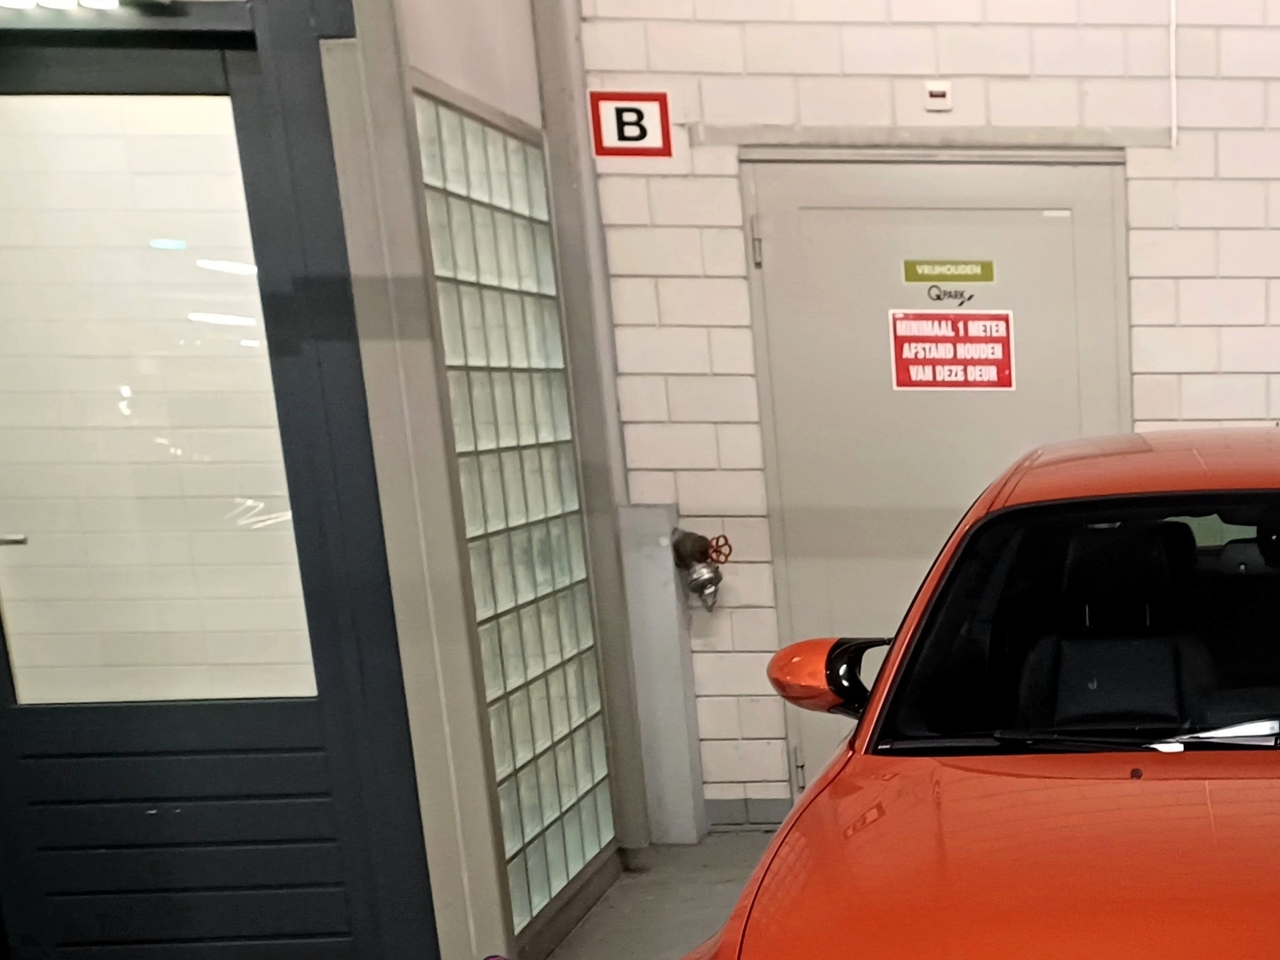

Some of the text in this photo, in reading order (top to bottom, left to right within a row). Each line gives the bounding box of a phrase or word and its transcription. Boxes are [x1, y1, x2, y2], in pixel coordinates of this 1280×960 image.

[615, 106, 648, 142] B
[896, 319, 1007, 337] MINIMAAL 1 METER
[902, 342, 1003, 360] AFSTAND HOUDEN
[909, 365, 998, 382] VAN DEZE DEUR
